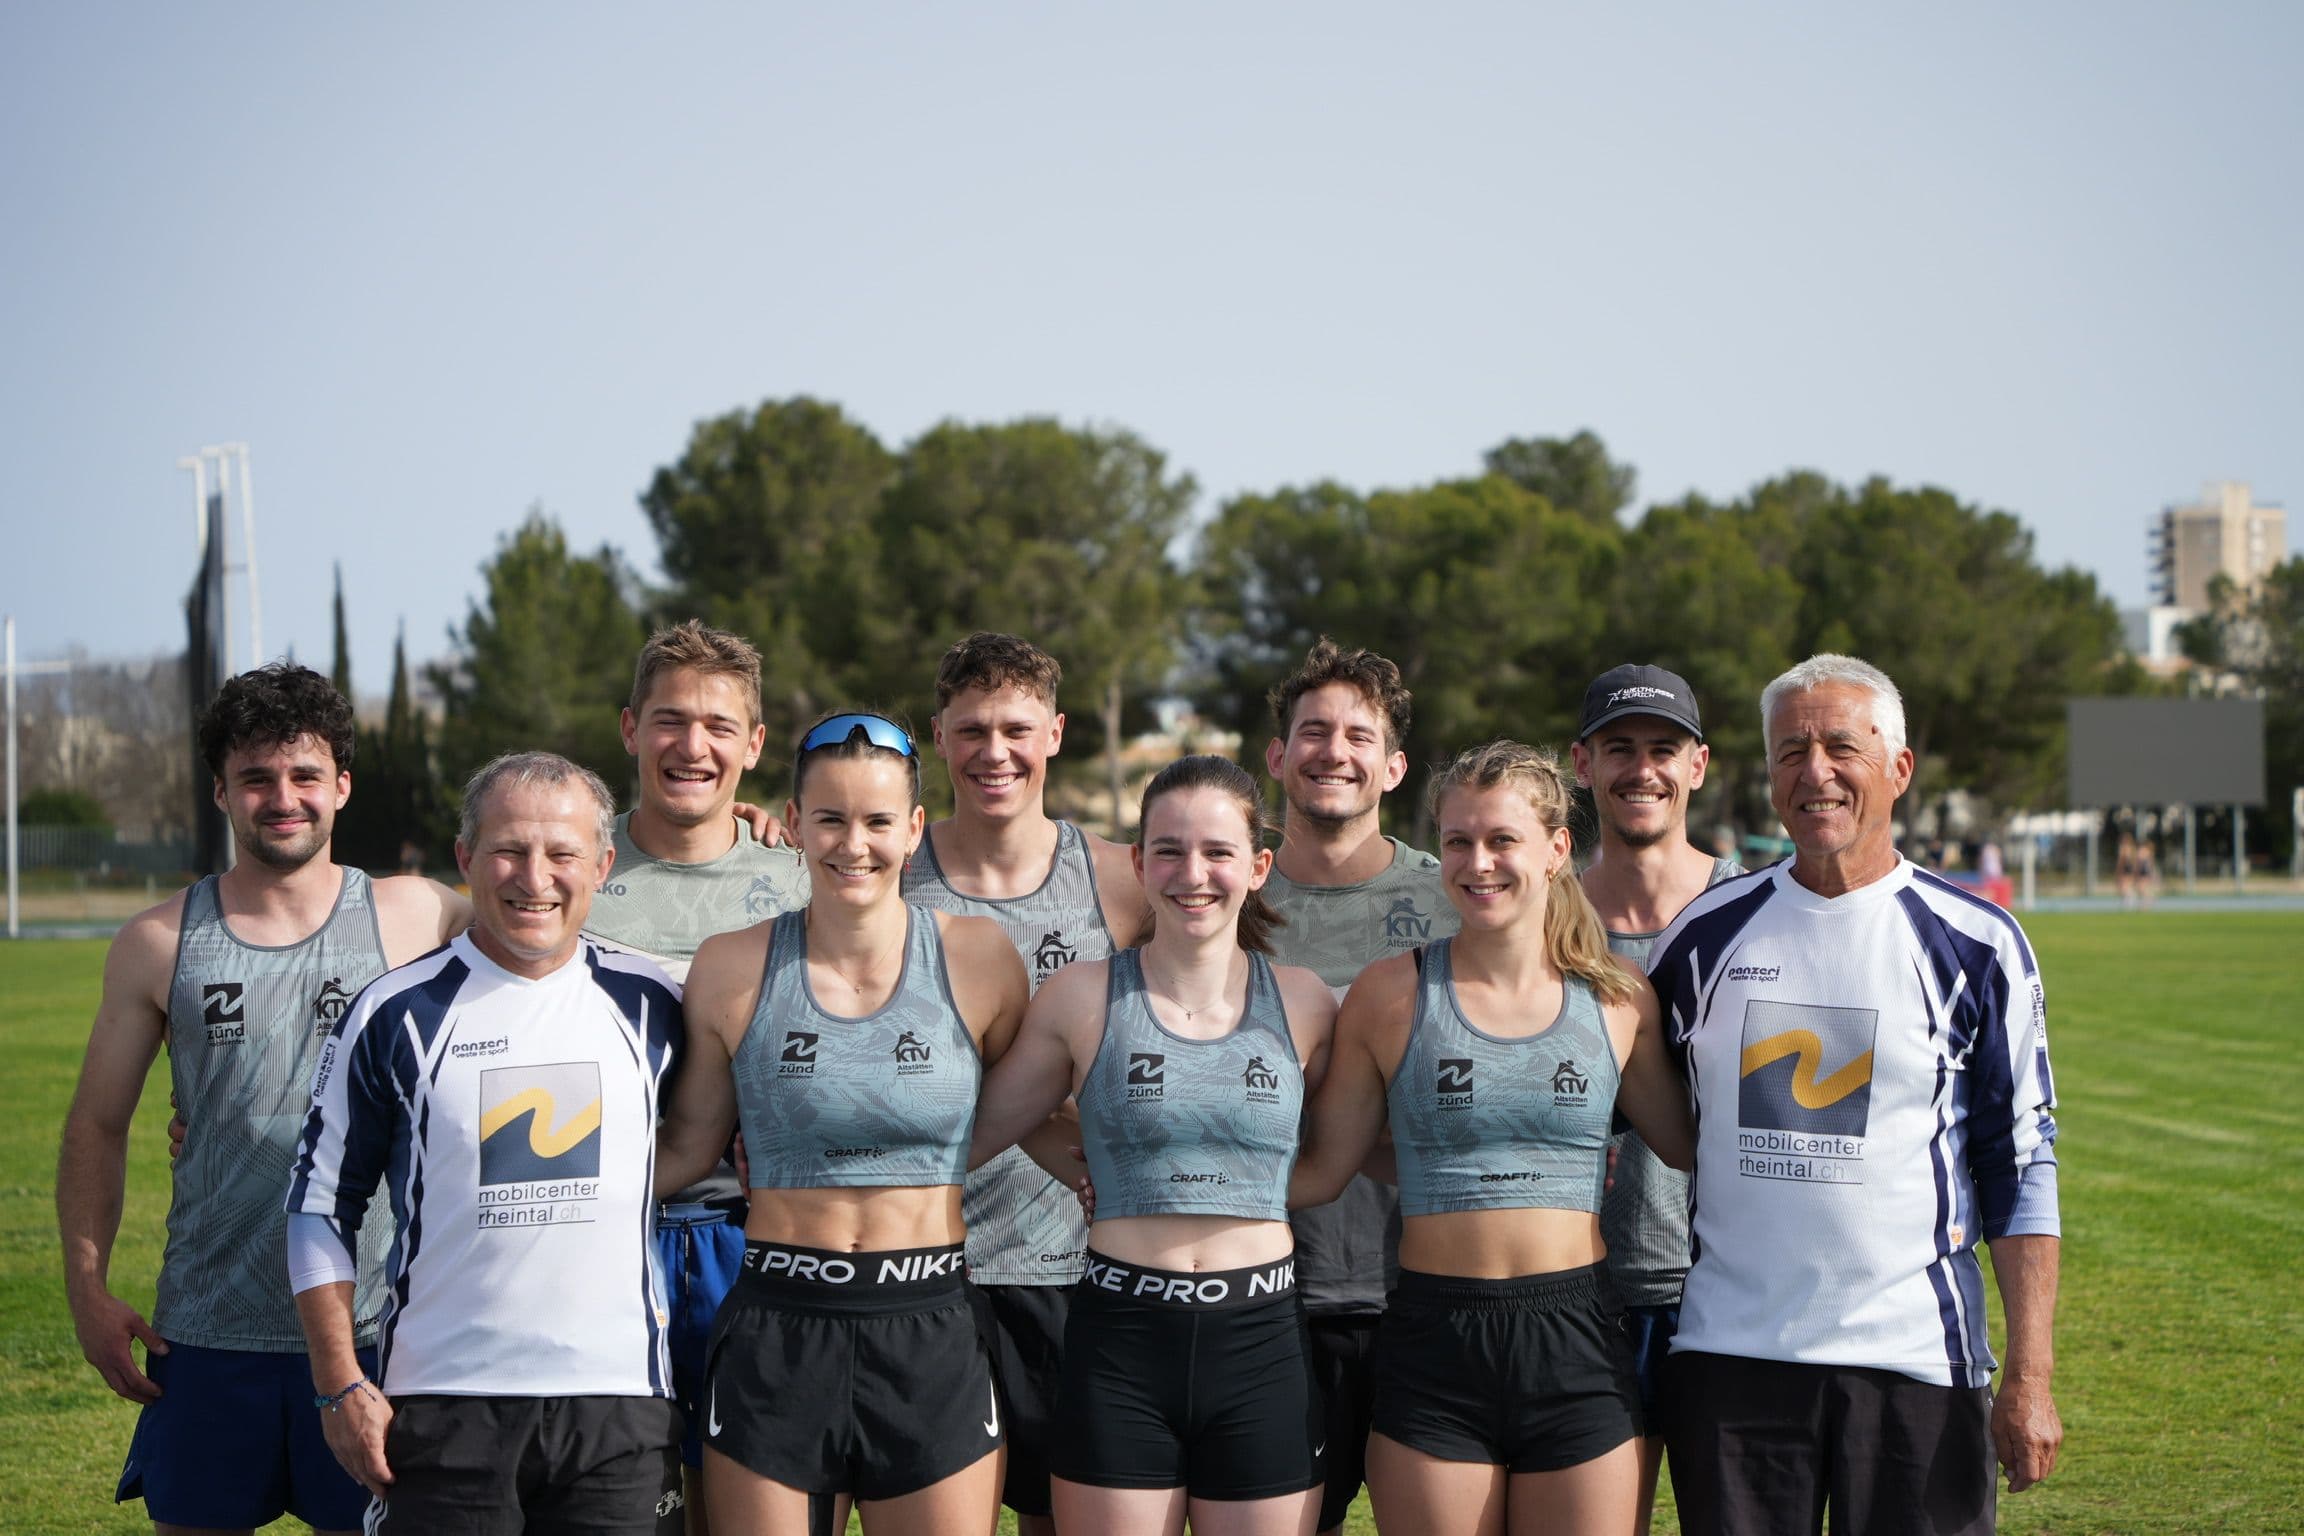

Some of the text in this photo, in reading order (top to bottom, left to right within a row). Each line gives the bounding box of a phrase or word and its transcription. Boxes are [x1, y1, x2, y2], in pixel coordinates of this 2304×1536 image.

[1386, 916, 1432, 938] KTV
[1036, 950, 1077, 970] KTV
[1728, 965, 1781, 978] panzeri
[207, 1023, 245, 1040] zünd
[451, 1035, 509, 1055] panzeri
[895, 1045, 931, 1063] KTV
[779, 1063, 815, 1074] zünd
[897, 1063, 934, 1071] Altstätten
[1245, 1073, 1279, 1090] KTV
[1553, 1077, 1589, 1094] KTV
[1127, 1085, 1164, 1098] zünd
[1246, 1090, 1280, 1099] Altstätten
[1554, 1095, 1588, 1103] Altstätten
[1437, 1093, 1473, 1106] zünd
[1739, 1132, 1864, 1155] mobilcenter
[824, 1148, 873, 1158] CRAFT
[1739, 1155, 1845, 1179] rheintal.ch
[1170, 1174, 1217, 1183] CRAFT
[1480, 1171, 1530, 1182] CRAFT
[478, 1181, 600, 1203] mobilcenter
[1041, 1251, 1079, 1263] CRAFT
[761, 1251, 856, 1284] PRO
[1085, 1256, 1295, 1304] KE PRO NIK
[352, 1315, 378, 1328] AFT
